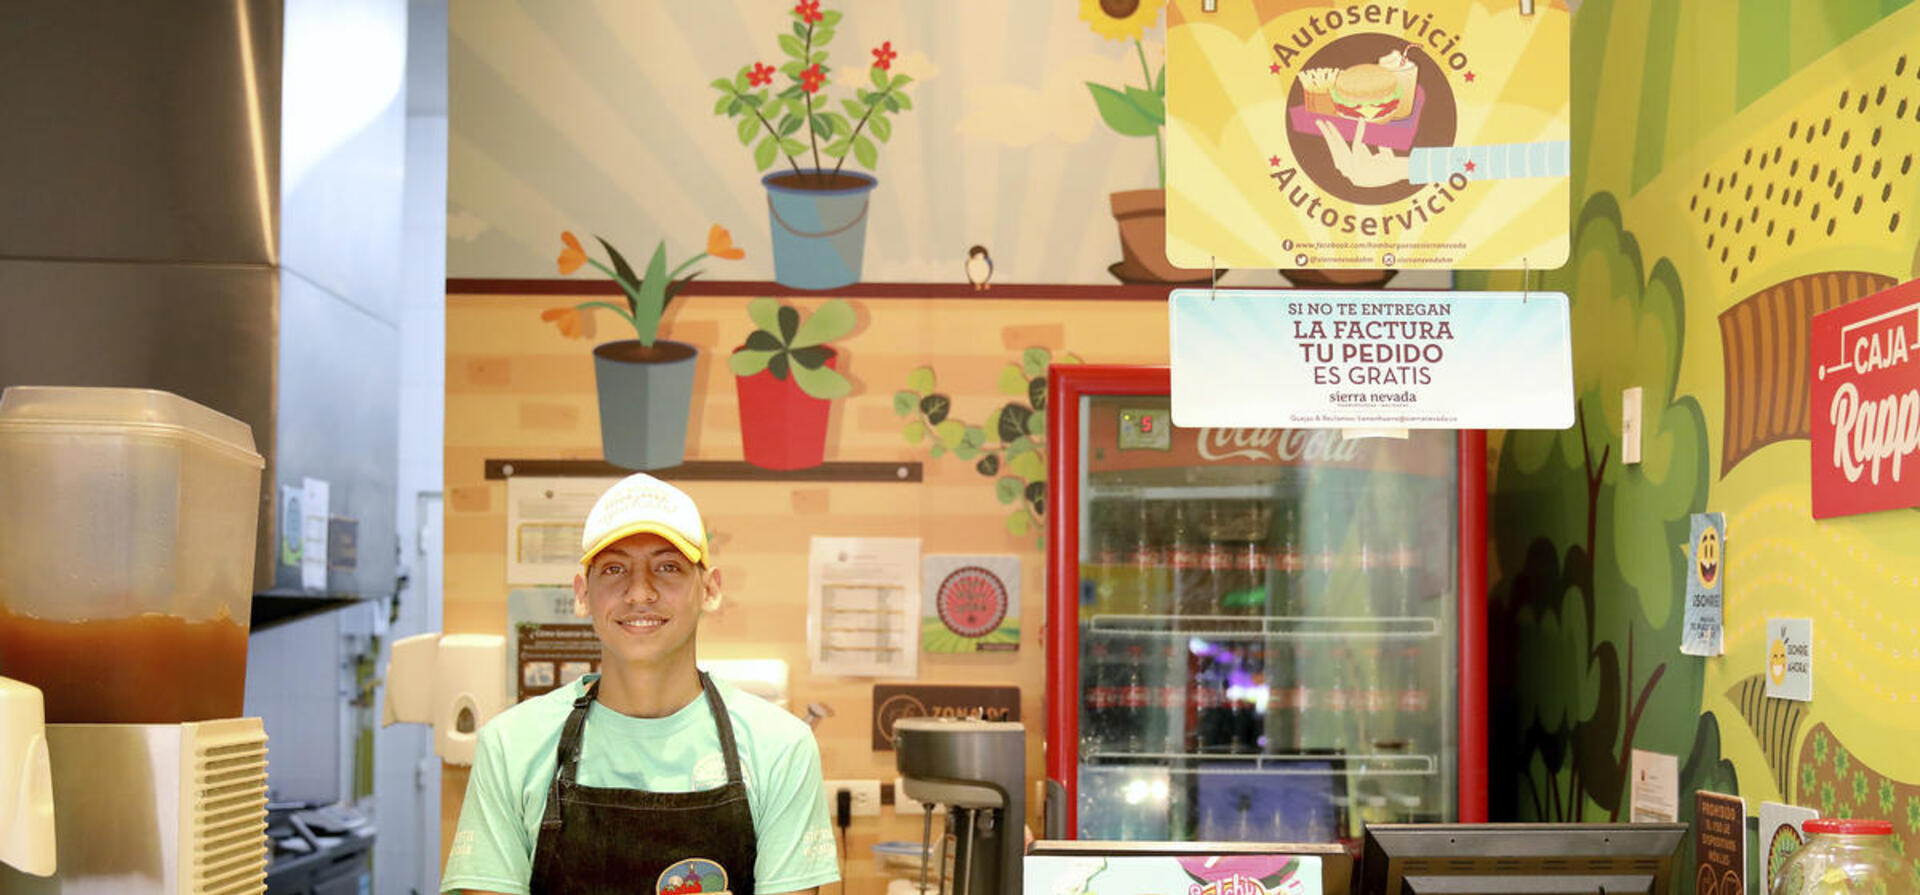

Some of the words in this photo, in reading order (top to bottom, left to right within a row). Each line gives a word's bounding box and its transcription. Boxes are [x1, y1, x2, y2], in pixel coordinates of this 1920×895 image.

[1272, 3, 1467, 71] Autoservicio
[1270, 166, 1468, 236] Autoservicio
[1288, 303, 1304, 316] SI
[1307, 303, 1333, 316] NO
[1337, 303, 1358, 316] TE
[1361, 303, 1451, 316] ENTREGAN
[1294, 320, 1327, 339] LA
[1334, 320, 1454, 339] FACTURA
[1298, 343, 1334, 363] TU
[1343, 343, 1443, 363] PEDIDO
[1854, 327, 1908, 374] CAJA
[1314, 366, 1341, 385] ES
[1348, 366, 1432, 385] GRATIS
[1329, 390, 1367, 403] sierra
[1370, 390, 1417, 403] nevada
[1830, 382, 1920, 485] Rapp
